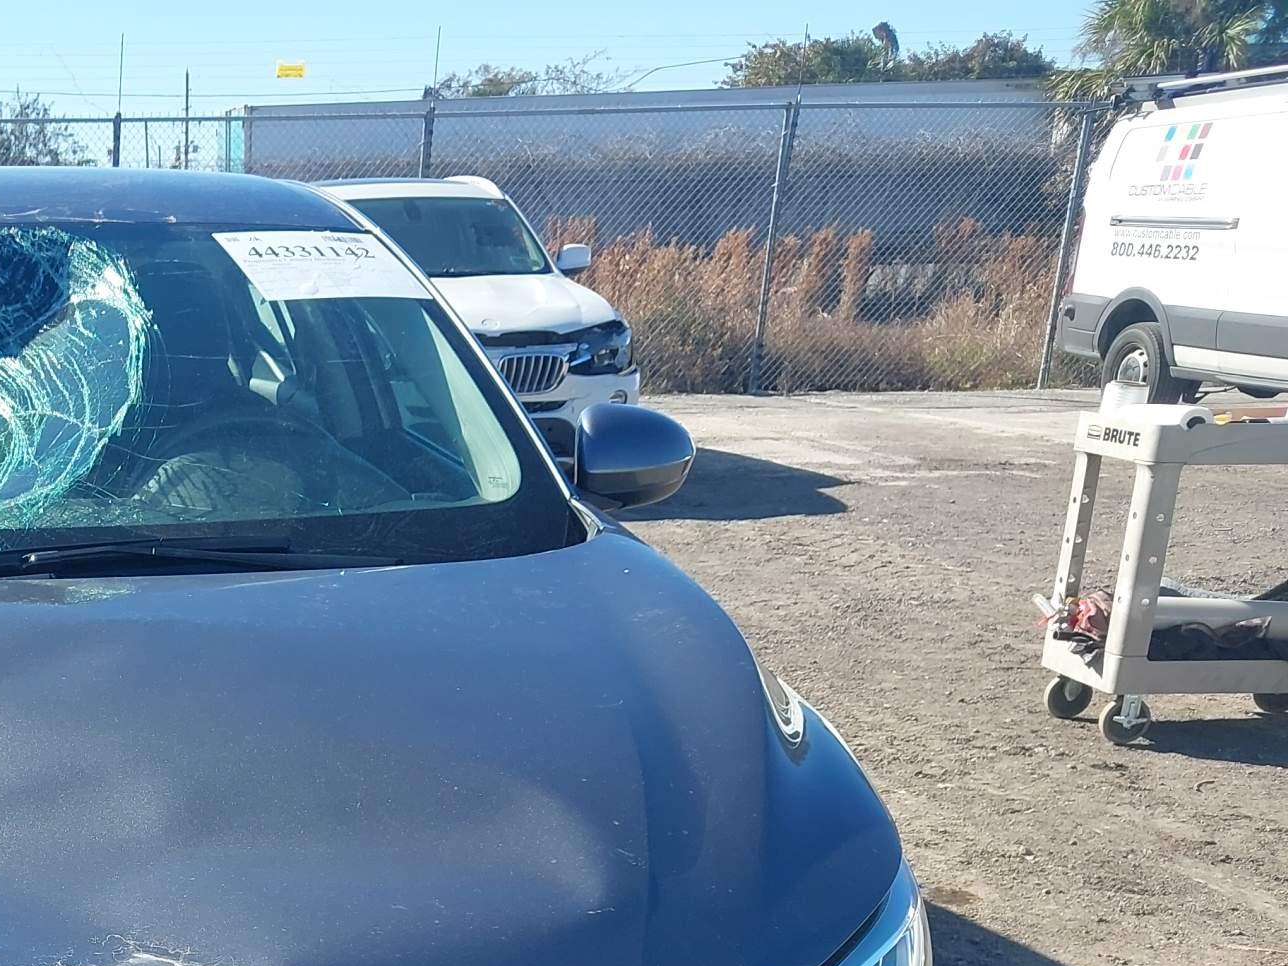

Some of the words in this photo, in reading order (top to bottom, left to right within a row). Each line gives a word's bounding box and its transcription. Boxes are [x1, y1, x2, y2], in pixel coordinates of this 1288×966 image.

[248, 245, 376, 259] 44331142
[1111, 242, 1200, 260] 800.446.2232
[1102, 427, 1141, 447] BRUTE
